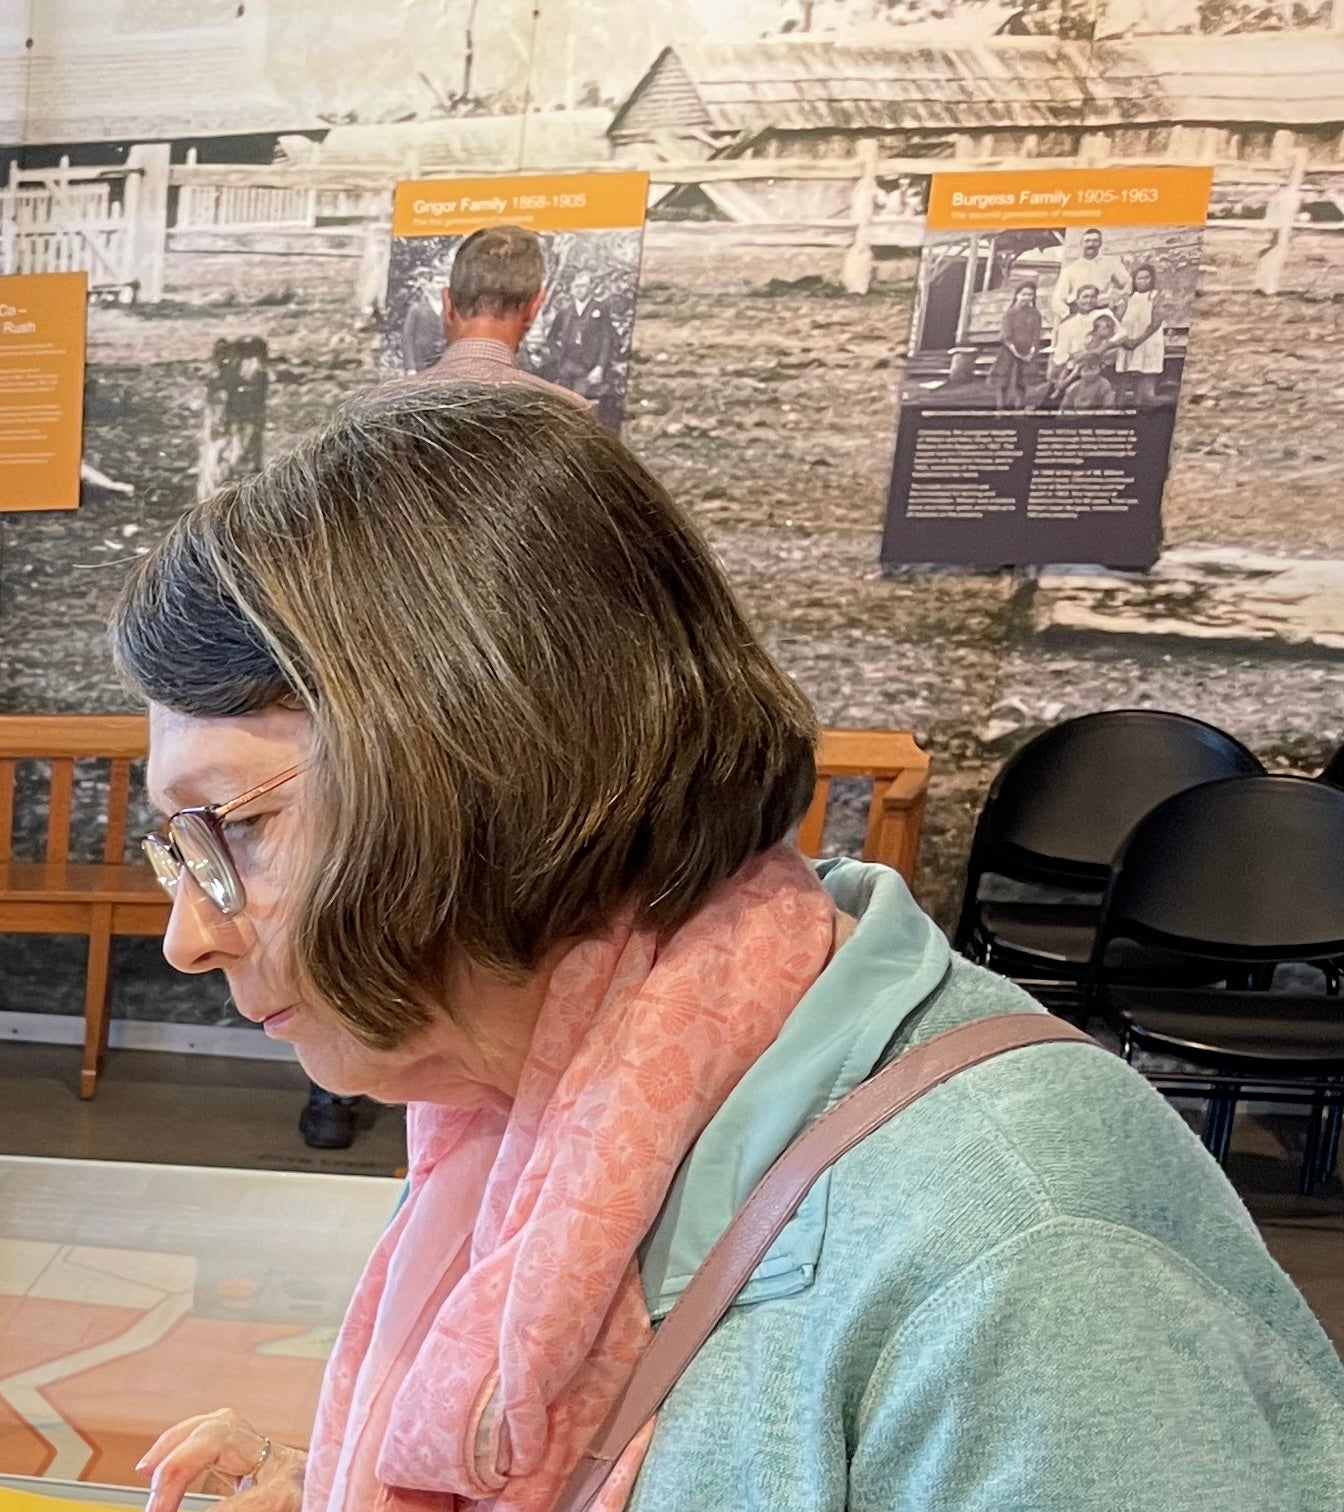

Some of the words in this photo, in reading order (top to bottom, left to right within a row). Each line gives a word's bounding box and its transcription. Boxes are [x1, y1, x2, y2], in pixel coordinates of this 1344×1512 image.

[413, 199, 456, 216] Grigor
[460, 197, 507, 213] Family
[952, 190, 1015, 208] Burgess
[1019, 189, 1071, 206] Family
[1077, 188, 1158, 203] 1905-1963
[3, 321, 36, 334] Rush
